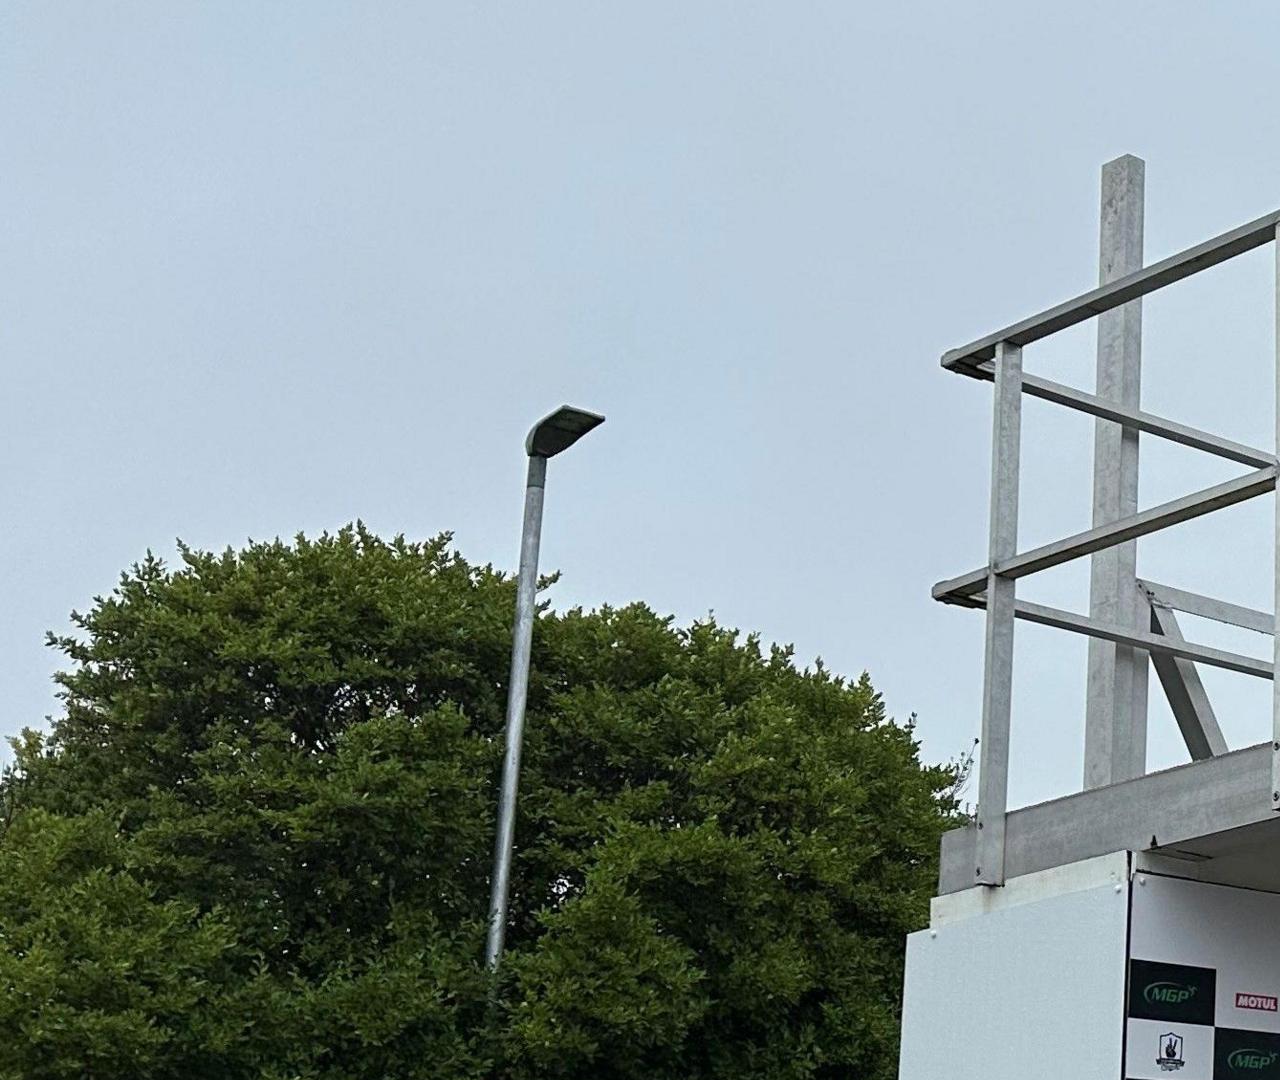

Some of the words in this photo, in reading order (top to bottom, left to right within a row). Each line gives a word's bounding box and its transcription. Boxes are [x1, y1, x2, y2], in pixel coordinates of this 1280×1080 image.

[1150, 986, 1189, 1003] MGP
[1236, 994, 1276, 1010] MOTUL
[1234, 1053, 1271, 1069] MGP
